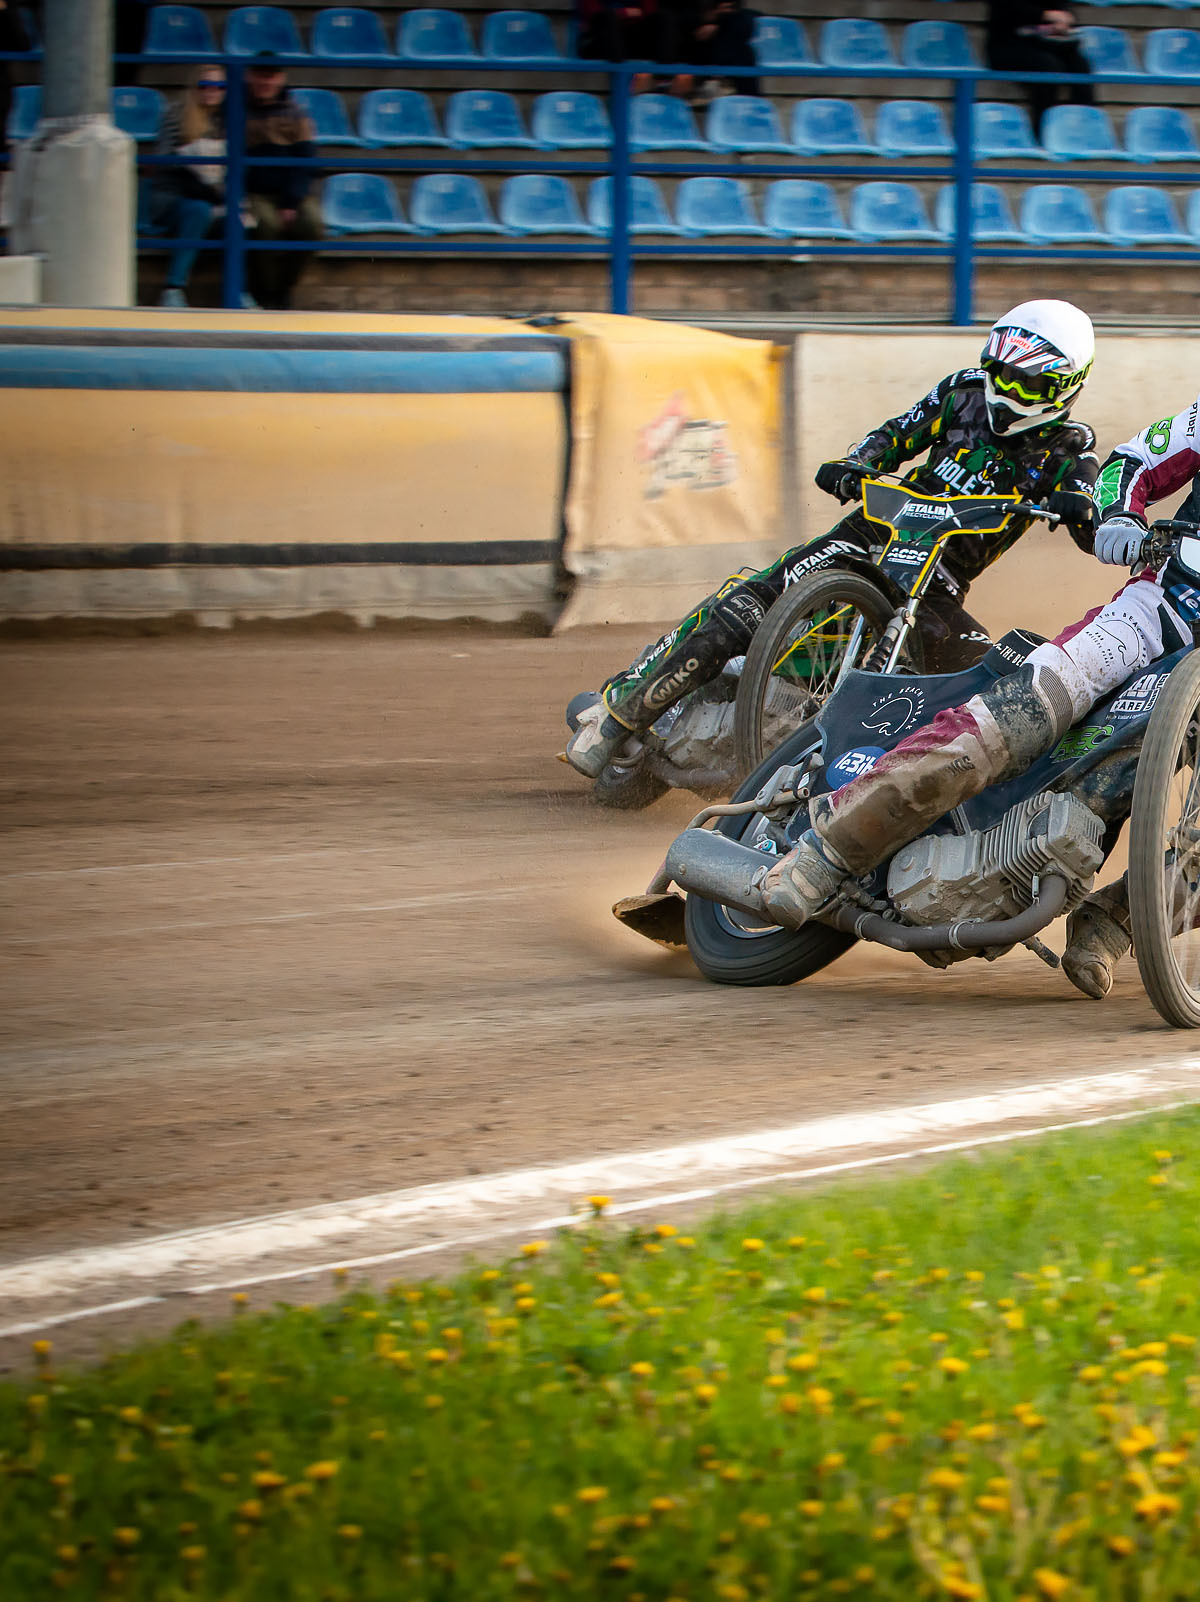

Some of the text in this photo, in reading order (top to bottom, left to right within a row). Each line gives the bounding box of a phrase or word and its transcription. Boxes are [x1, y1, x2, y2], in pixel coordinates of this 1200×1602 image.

[1186, 402, 1198, 438] PTIBET
[933, 456, 979, 496] HOLE
[891, 498, 962, 528] METALIKA
[905, 511, 945, 521] RECYCLING
[782, 540, 868, 593] METALIKA
[887, 547, 929, 562] ACDC
[1000, 645, 1016, 661] THE
[652, 657, 700, 701] WIKO
[872, 693, 893, 707] THE
[899, 686, 924, 697] BEACH
